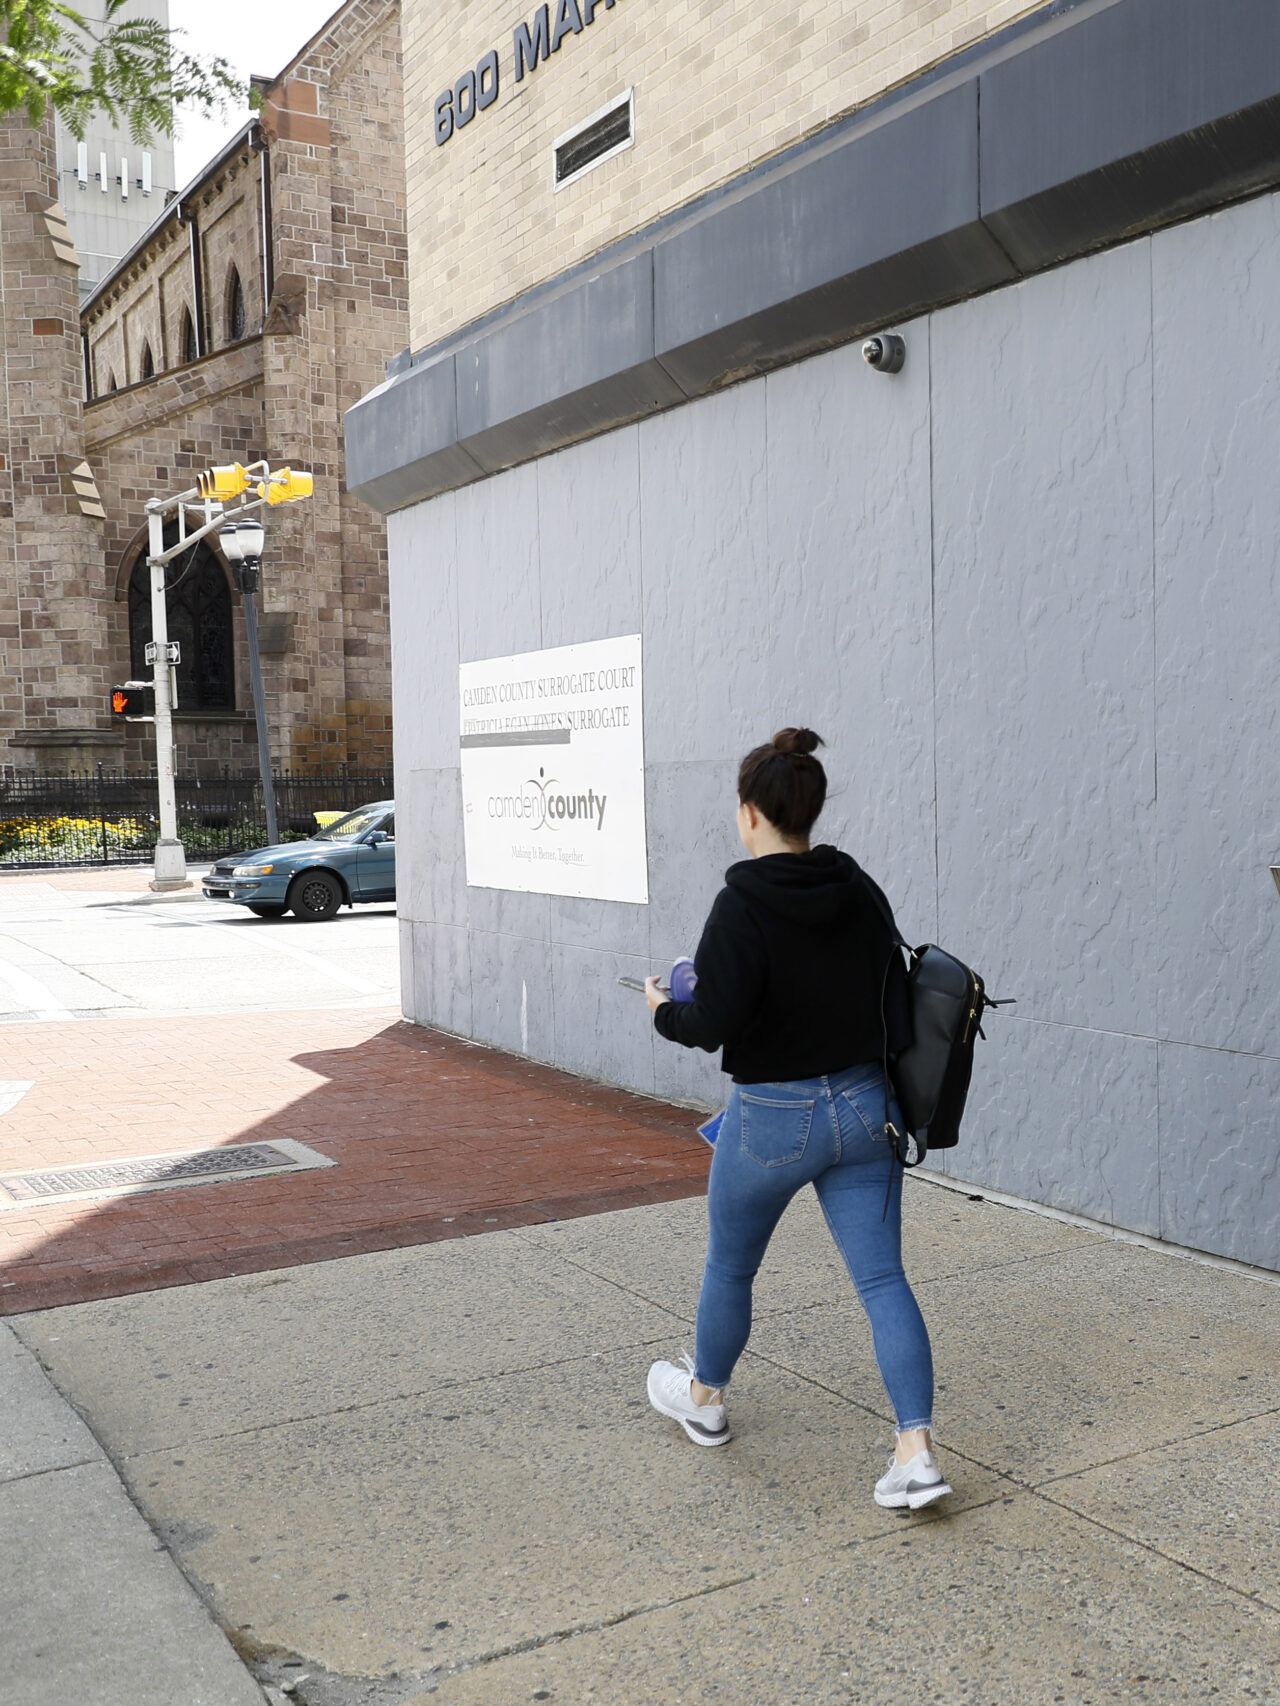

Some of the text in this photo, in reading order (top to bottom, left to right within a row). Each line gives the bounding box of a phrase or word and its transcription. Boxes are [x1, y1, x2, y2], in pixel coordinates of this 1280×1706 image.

[434, 49, 499, 146] 600
[463, 666, 636, 707] CAMDEN COUNTY SURROGATE COURT
[567, 706, 630, 730] SURROGATE
[488, 784, 607, 830] camden county
